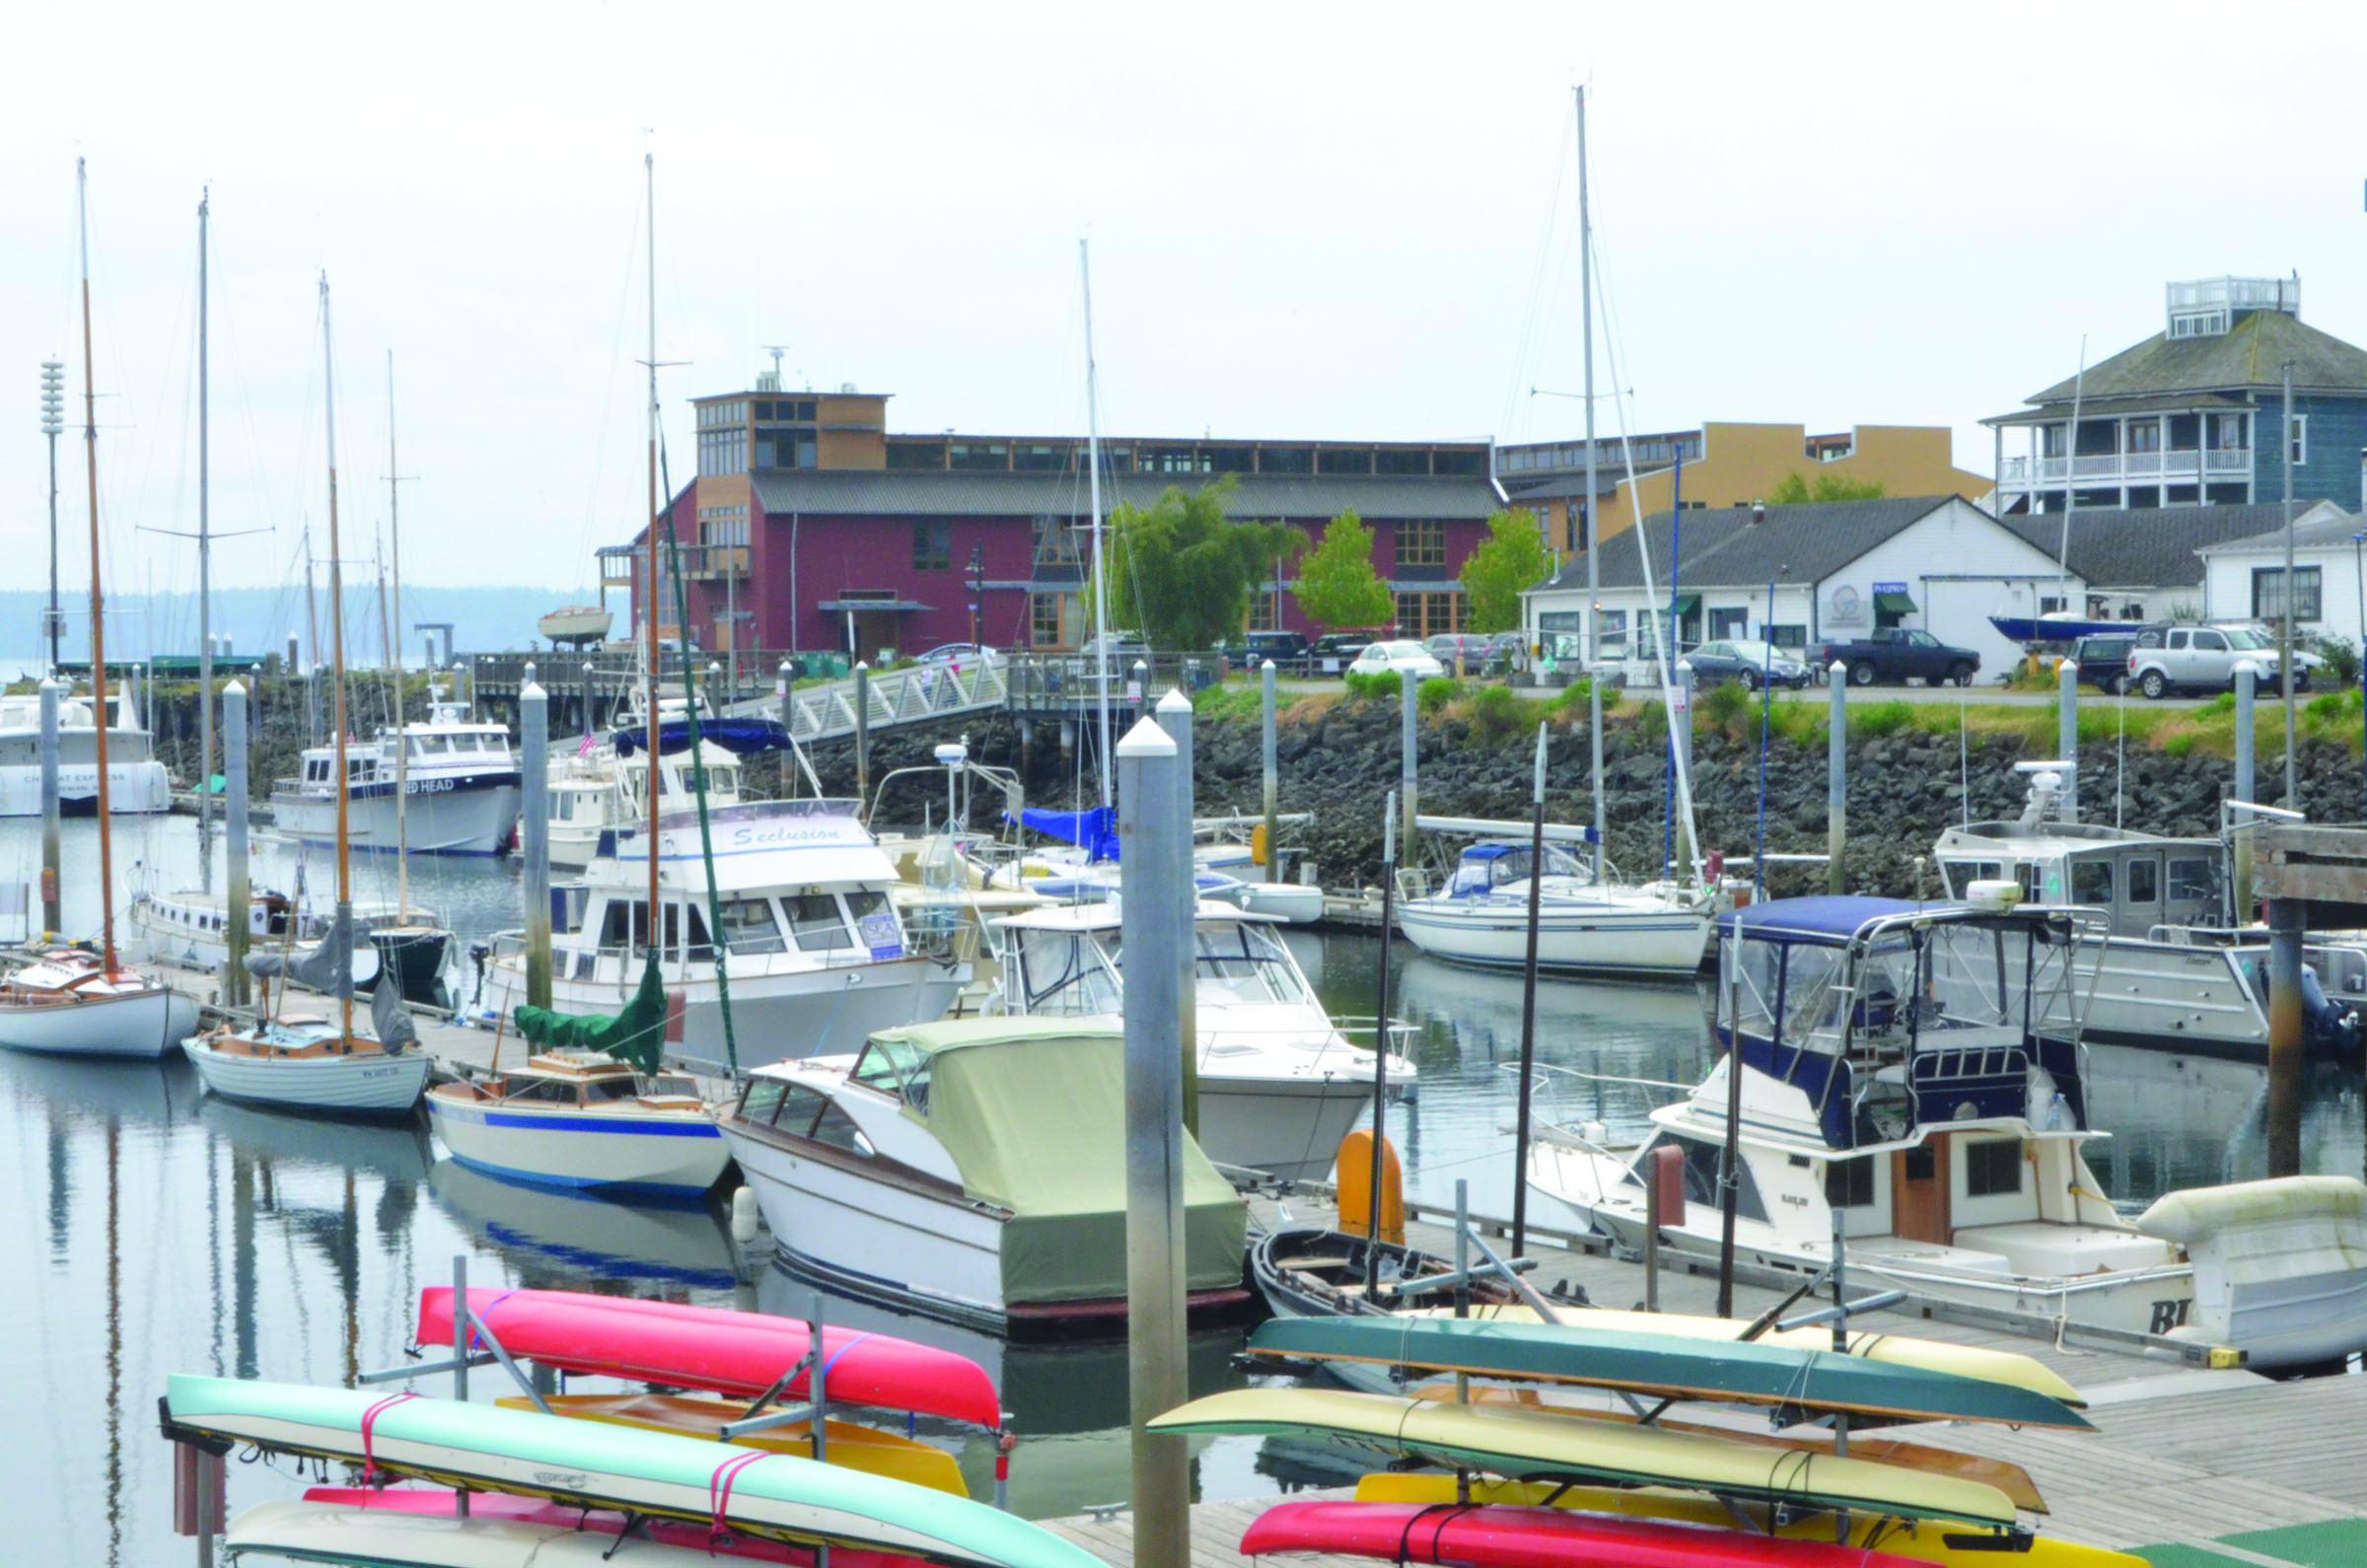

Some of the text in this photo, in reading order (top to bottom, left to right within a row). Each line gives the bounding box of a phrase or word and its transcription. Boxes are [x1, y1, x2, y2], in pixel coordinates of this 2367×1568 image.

[24, 772, 125, 783] CHAT EXPESS
[420, 779, 455, 793] HEAD
[734, 827, 840, 845] Seclusion
